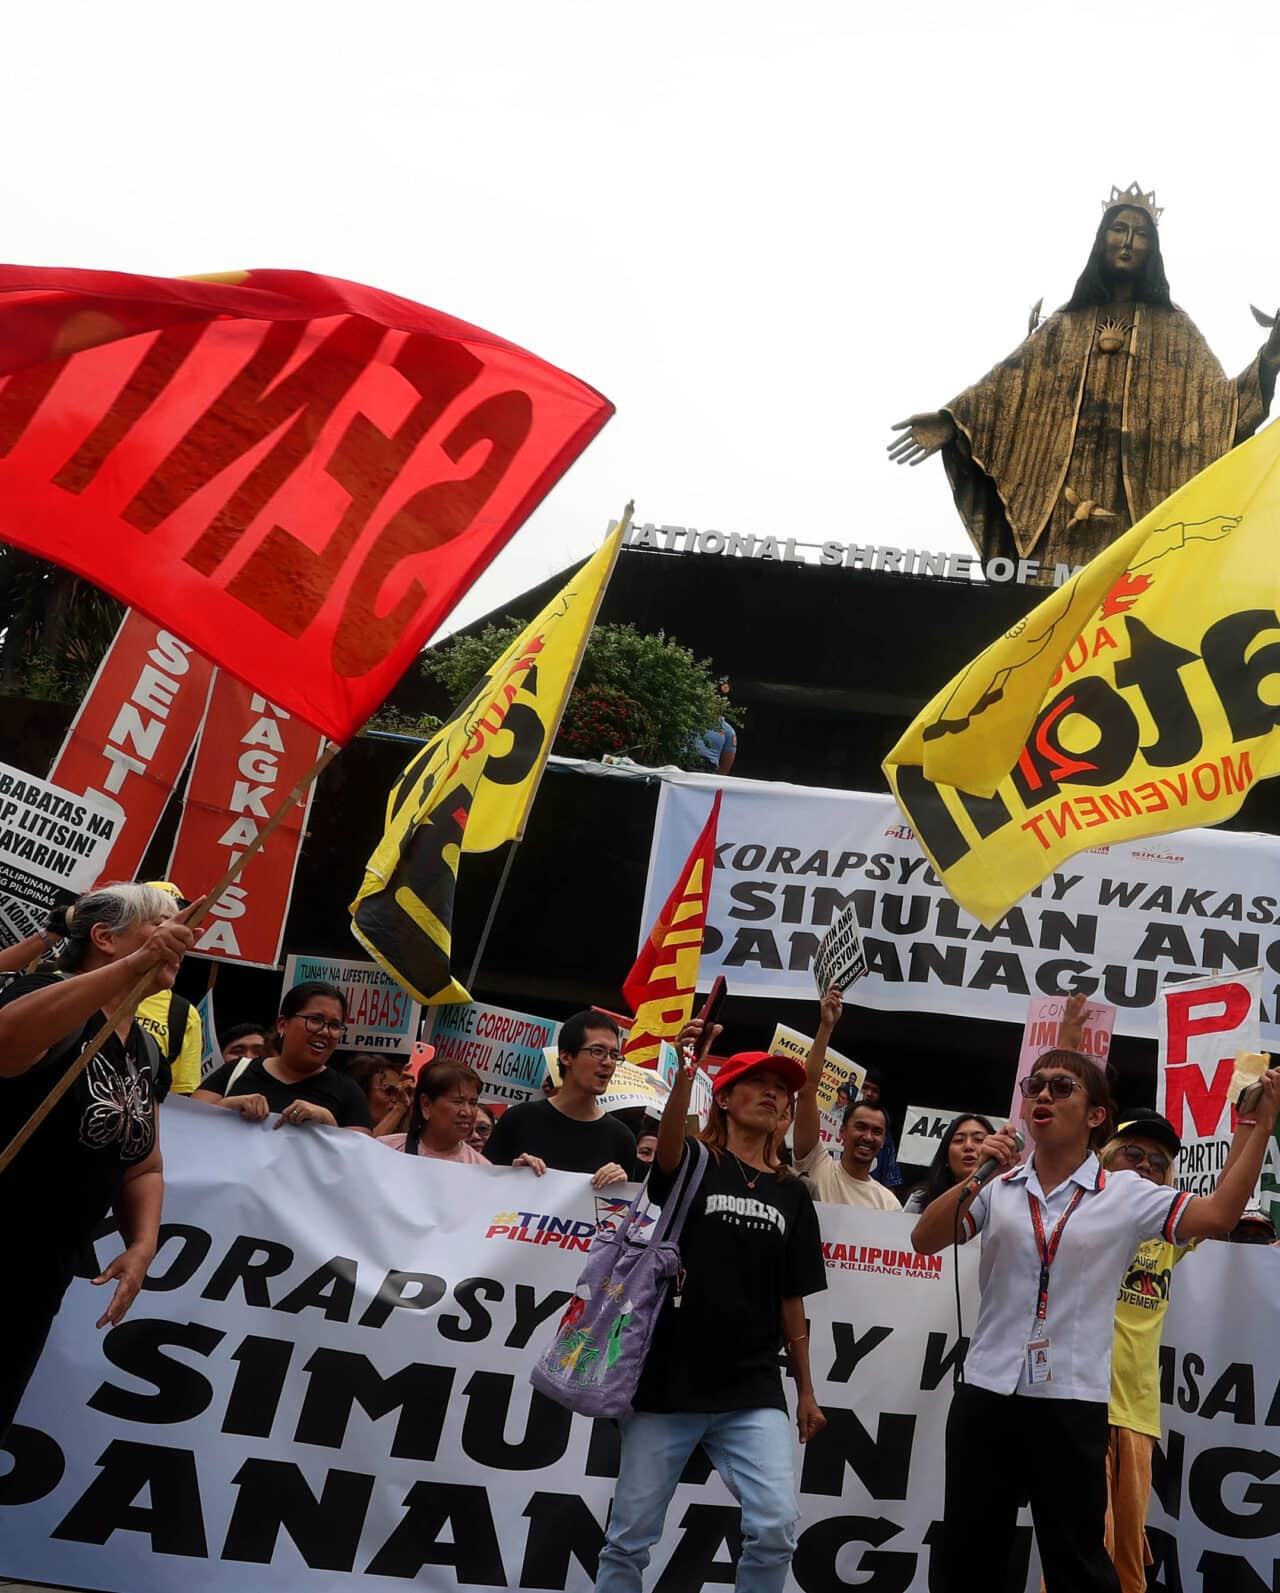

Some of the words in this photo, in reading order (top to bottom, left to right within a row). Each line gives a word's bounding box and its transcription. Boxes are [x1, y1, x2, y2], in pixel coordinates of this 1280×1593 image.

[819, 541, 972, 580] SHRINE
[986, 557, 1038, 585] OF
[0, 773, 87, 827] BABATAS
[86, 813, 115, 840] NA
[18, 810, 97, 858] LITISIN!
[9, 881, 55, 906] PILIPINAS
[728, 881, 1098, 955] SIMULAN
[301, 964, 328, 980] TUNAY
[329, 968, 341, 981] NA
[354, 1035, 402, 1048] PARTY
[475, 1012, 550, 1049] CORRUPTION
[778, 1038, 804, 1054] MGA
[1029, 1021, 1110, 1057] IMAC
[433, 1033, 492, 1071] SHAMEFUL
[492, 1049, 542, 1085] AGAIN!
[494, 1212, 597, 1237] #TIND
[704, 1194, 786, 1236] BROOKLYN
[485, 1225, 592, 1253] PILIPIN
[840, 1263, 902, 1276] KILUSANG
[906, 1269, 941, 1280] MASA
